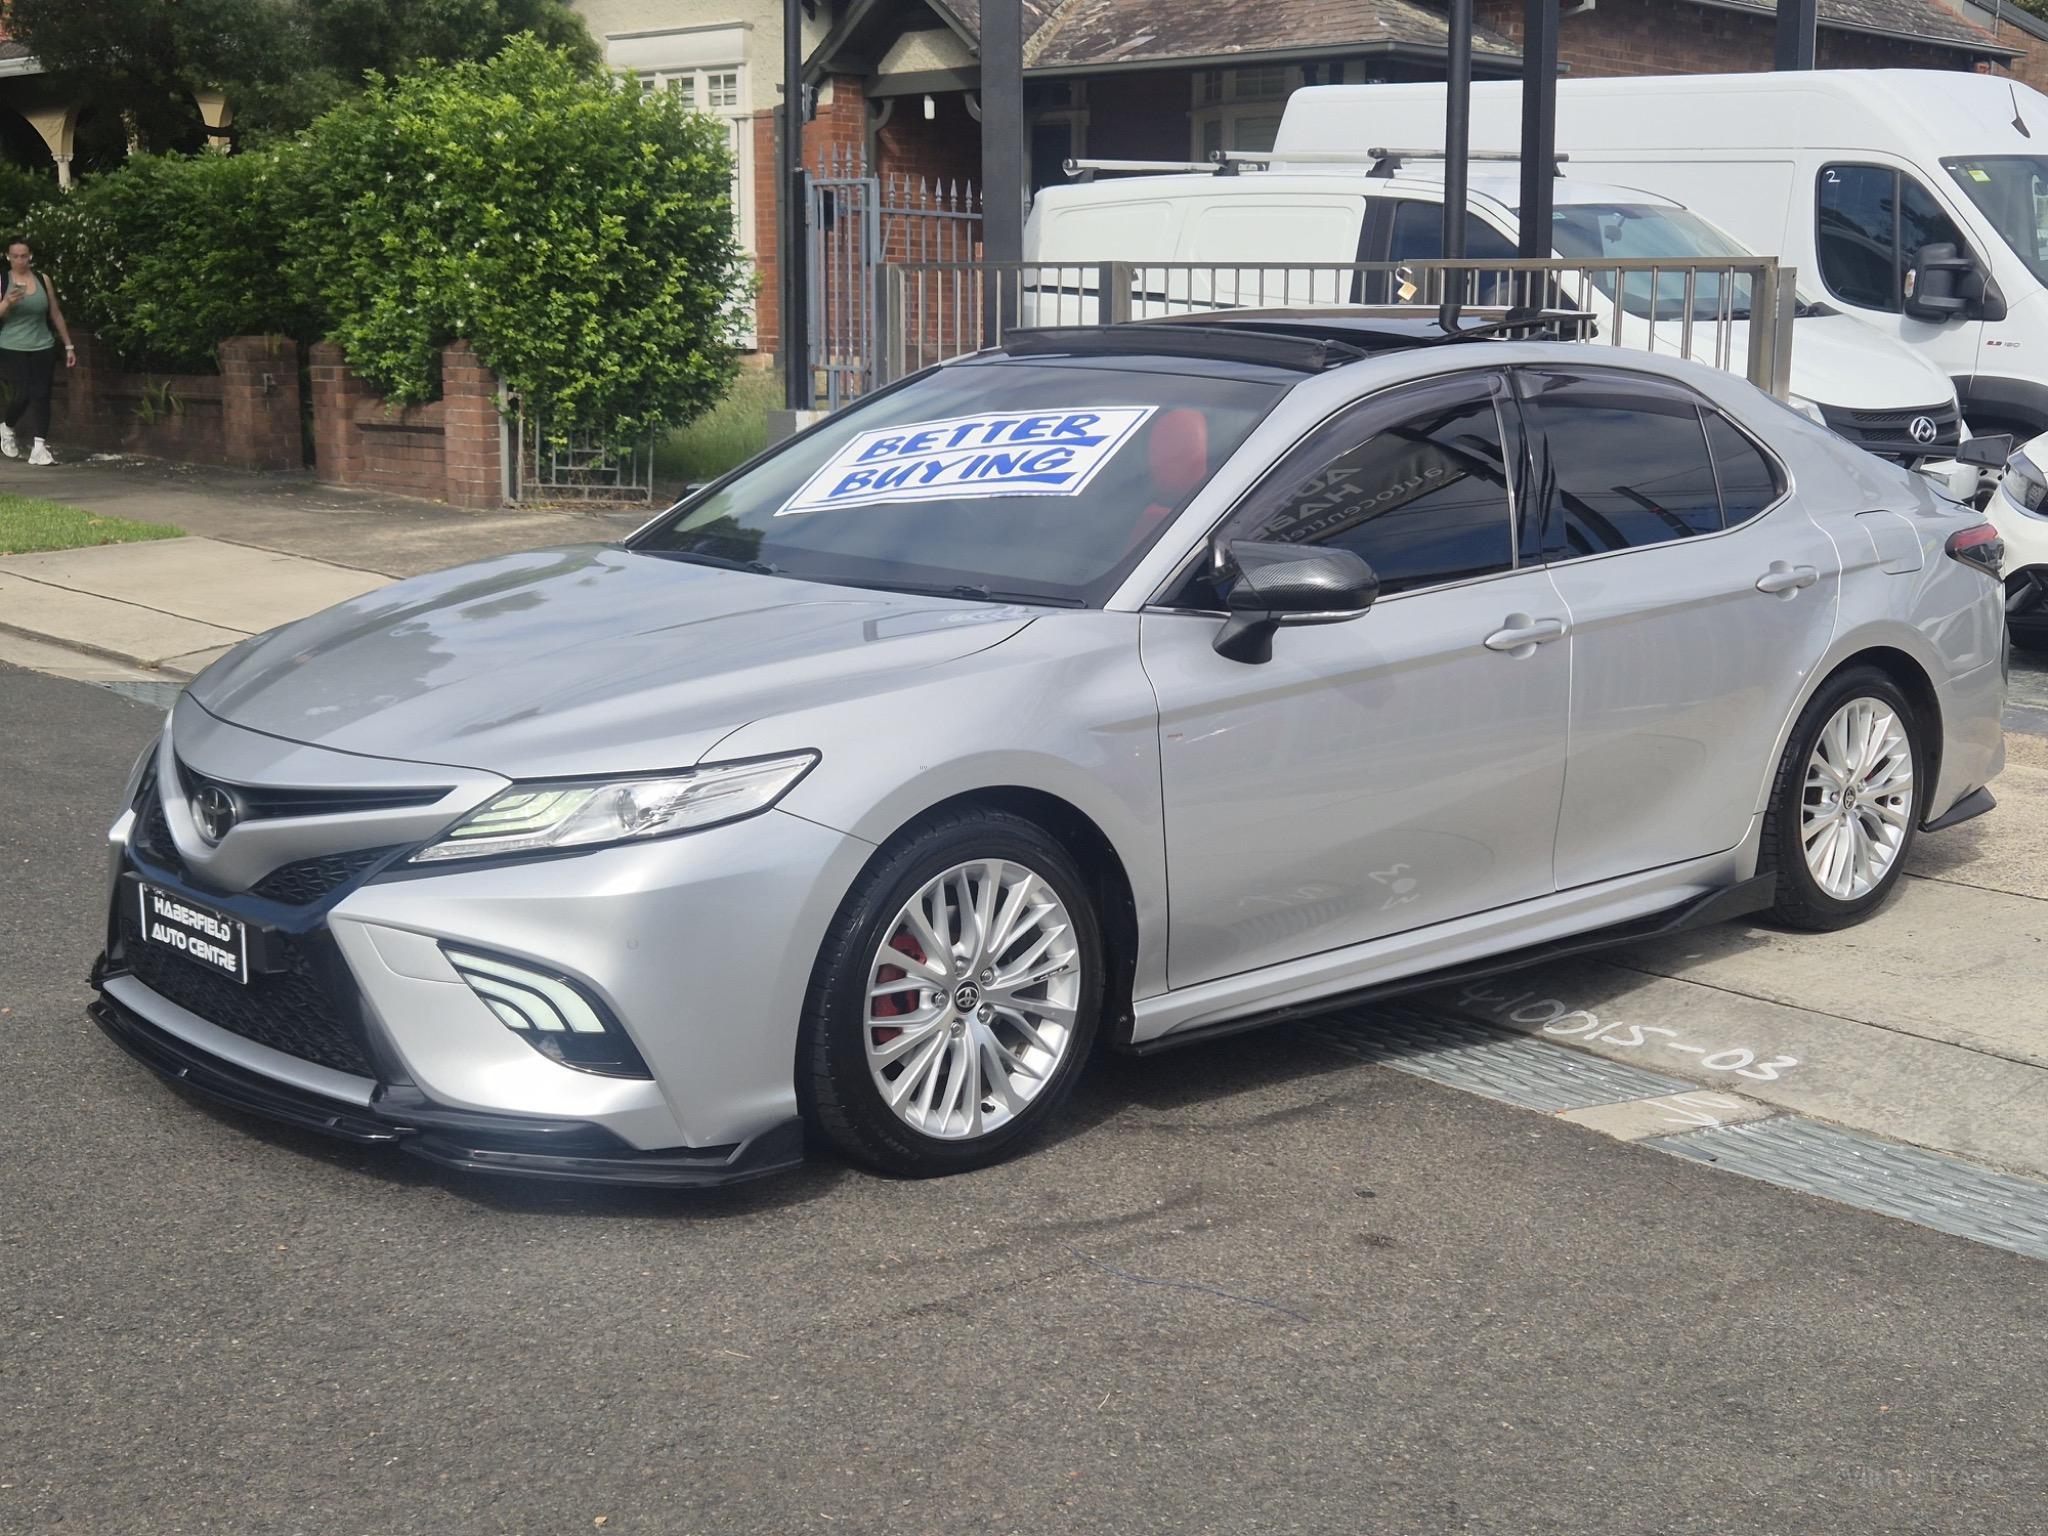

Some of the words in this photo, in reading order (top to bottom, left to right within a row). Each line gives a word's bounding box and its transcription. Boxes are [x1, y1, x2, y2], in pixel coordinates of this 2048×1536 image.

[856, 414, 1101, 462] BETTER
[828, 447, 1075, 497] BUYING
[153, 896, 231, 942] HABERFIELD
[151, 922, 187, 950] AUTO
[188, 936, 237, 973] CENTRE
